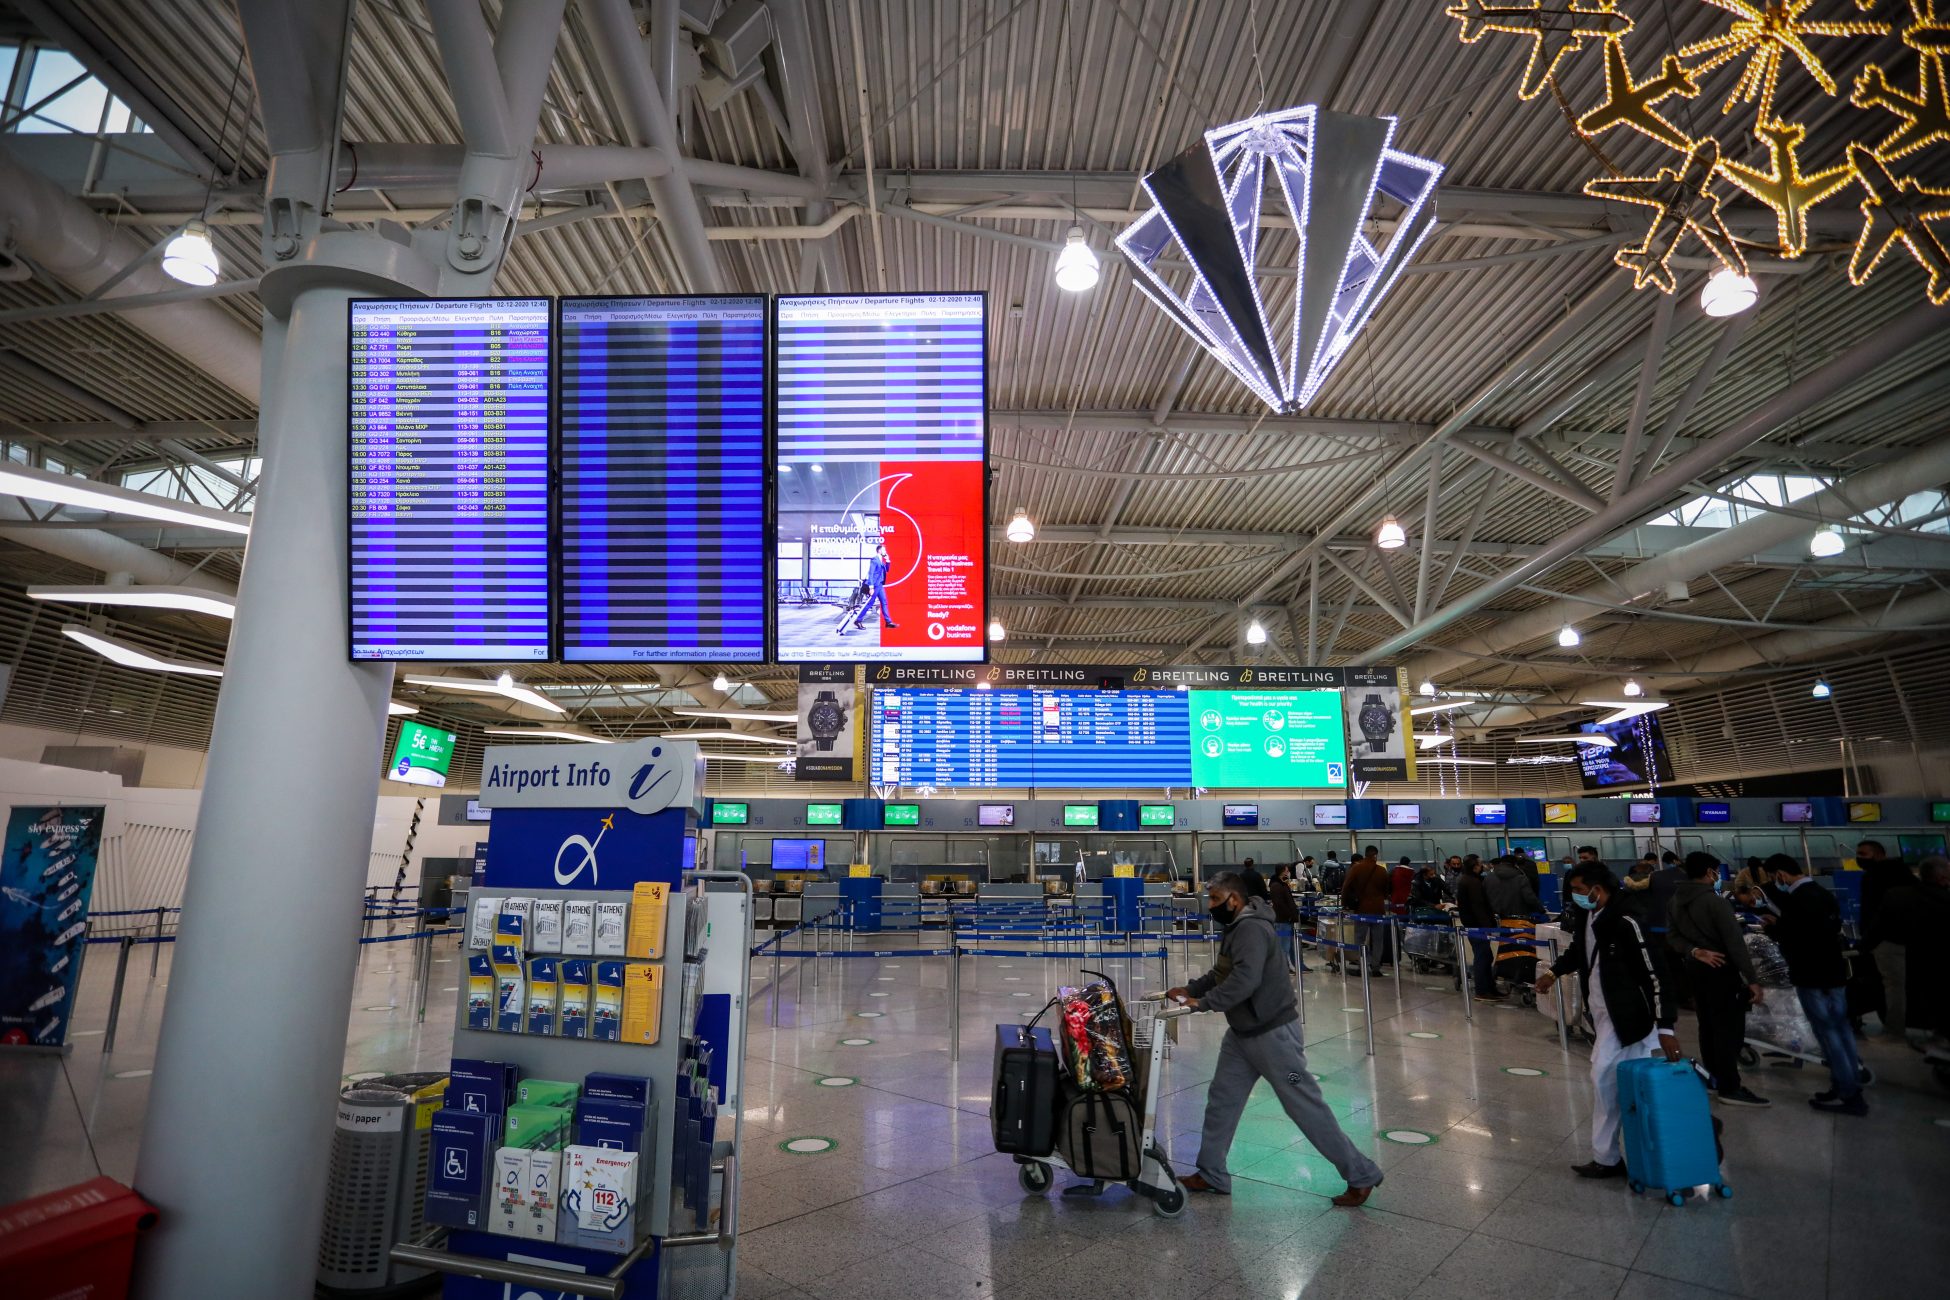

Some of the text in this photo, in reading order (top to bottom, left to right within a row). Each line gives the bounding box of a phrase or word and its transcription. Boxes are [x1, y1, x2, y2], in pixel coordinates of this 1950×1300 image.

[928, 610, 950, 620] Ready?
[896, 669, 975, 679] BREITLING
[1006, 670, 1084, 680] BREITLING
[1152, 671, 1230, 681] BREITLING
[1258, 672, 1334, 682] BREITLING
[411, 733, 427, 749] 5€
[487, 762, 610, 793] Airport Info
[754, 817, 763, 825] 58
[794, 817, 802, 825] 57
[925, 818, 934, 826] 56
[964, 818, 973, 826] 55
[1051, 818, 1060, 827] 54
[28, 824, 80, 835] sky express
[509, 902, 528, 912] ATHENS
[541, 903, 560, 912] ATHENS
[572, 906, 591, 914] ATHENS
[603, 905, 623, 914] ATHENS
[356, 1115, 381, 1124] paper
[596, 1158, 631, 1168] Emergency?
[595, 1192, 614, 1205] 112
